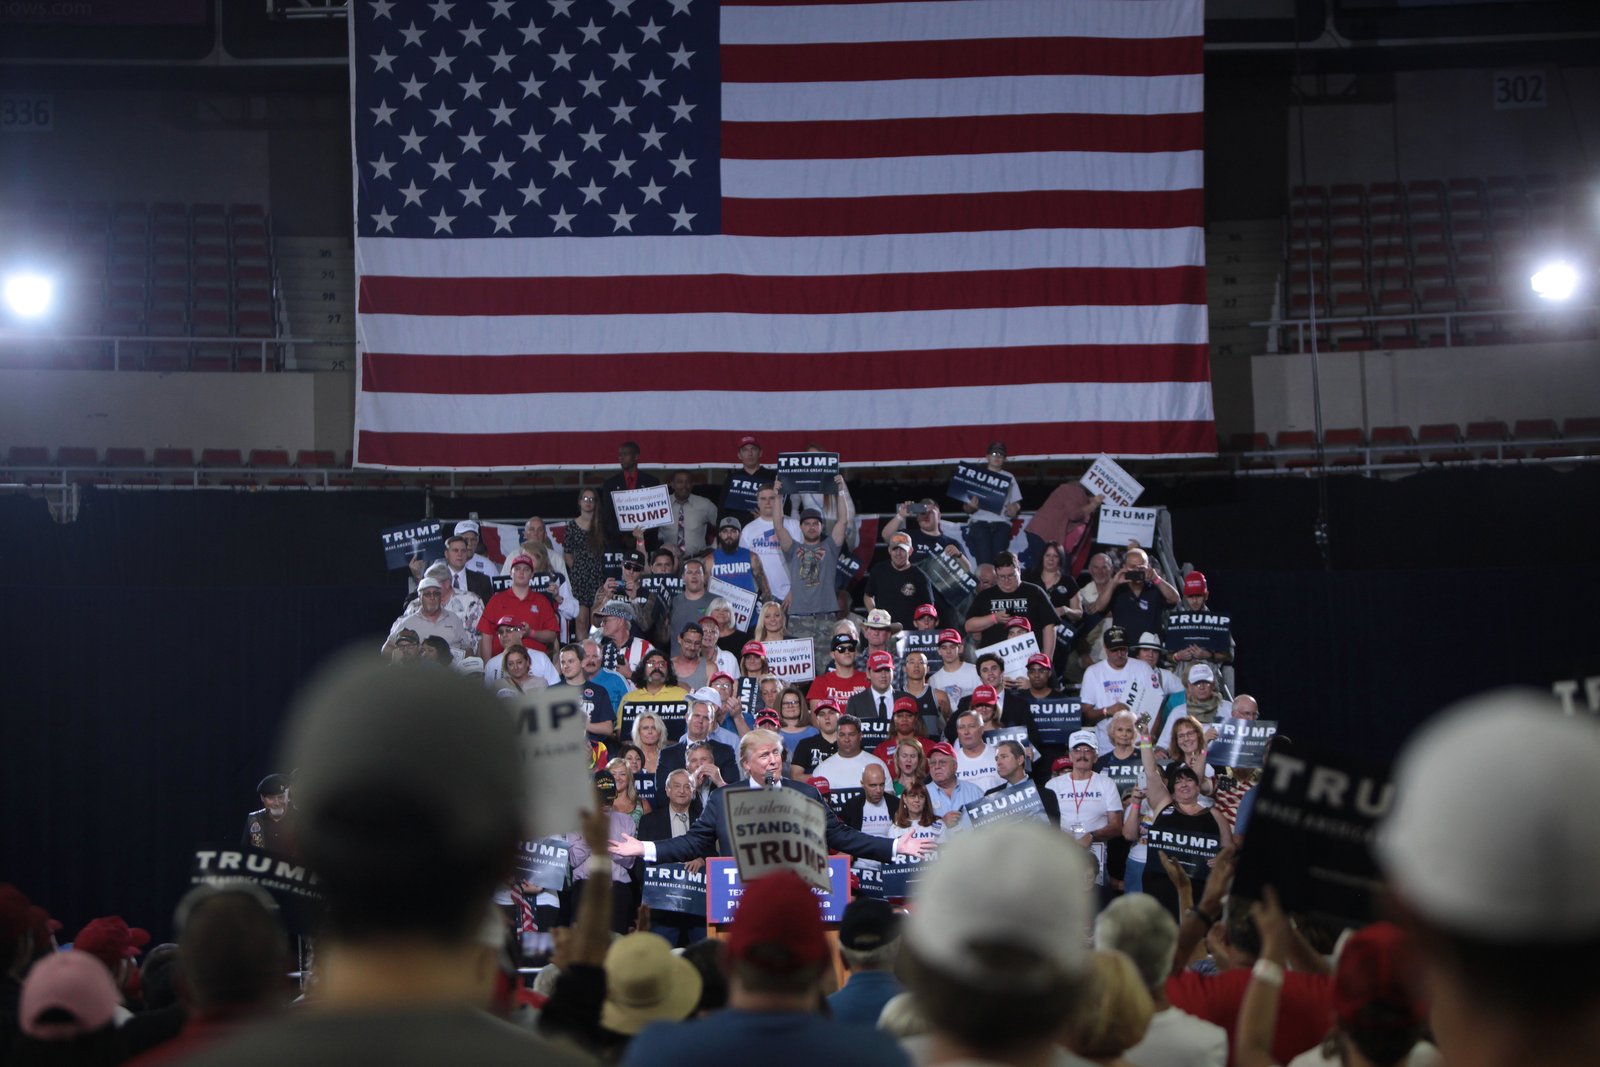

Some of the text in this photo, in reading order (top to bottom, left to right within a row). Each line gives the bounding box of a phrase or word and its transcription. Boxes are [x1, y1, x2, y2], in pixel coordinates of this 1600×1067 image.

[1497, 75, 1542, 103] 302
[3, 100, 50, 125] 336
[779, 457, 837, 467] TRUMP
[957, 465, 1009, 489] TRUMP
[1093, 465, 1117, 487] STANDS
[1117, 485, 1133, 501] WITH
[1088, 471, 1129, 507] TRUMP
[618, 500, 667, 511] STANDS WITH
[619, 508, 669, 524] TRUMP
[1102, 508, 1154, 520] TRUMP
[382, 524, 440, 543] TRUMP
[714, 562, 750, 575] TRUMP
[493, 576, 550, 590] TRMP
[731, 602, 750, 613] WITH
[991, 600, 1028, 609] TRUMP
[1170, 614, 1230, 625] TRUMP
[789, 654, 810, 662] WITH
[767, 662, 811, 676] RUMP
[623, 704, 686, 715] TRUMP
[1029, 703, 1081, 714] RUMP
[1211, 723, 1276, 738] TRUMP
[956, 766, 997, 778] TRUMP
[1268, 754, 1395, 818] TRU
[1059, 791, 1102, 799] TRUMP
[734, 801, 754, 816] the
[969, 786, 1036, 819] TRUMP
[736, 821, 801, 837] STANDS
[1149, 830, 1218, 849] TRUMP
[740, 840, 827, 874] TRUMP
[1163, 844, 1183, 852] AMERICA
[1185, 848, 1199, 856] GREAT
[646, 867, 706, 885] TRUM
[261, 879, 291, 891] GREAT
[659, 881, 681, 889] AMERICA
